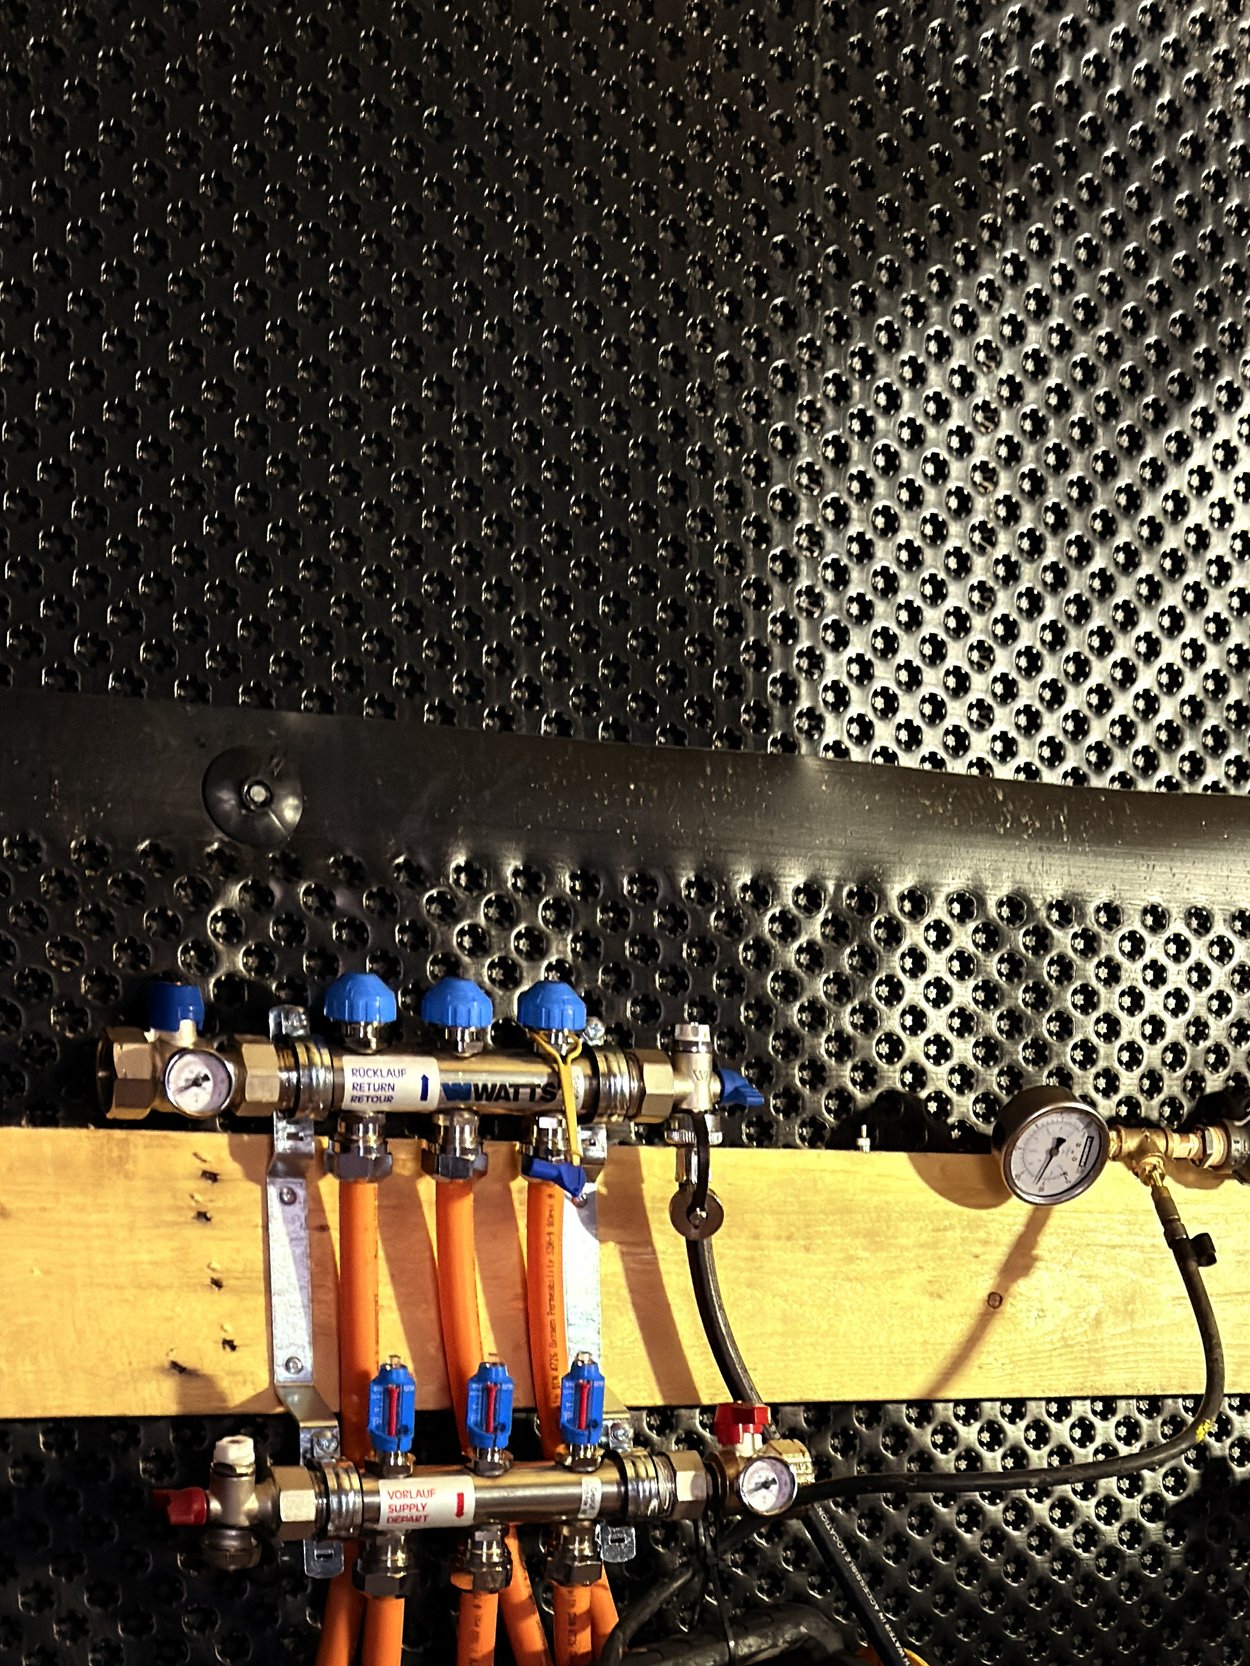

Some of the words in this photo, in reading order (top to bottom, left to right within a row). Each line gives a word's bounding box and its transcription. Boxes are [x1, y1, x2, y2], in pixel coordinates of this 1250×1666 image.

[351, 1082, 395, 1092] RETURN
[473, 1083, 558, 1103] WATTS
[350, 1094, 393, 1104] RETOUR
[387, 1489, 436, 1499] VORLAUF
[388, 1503, 427, 1513] SUPPLY
[846, 1556, 880, 1611] ACCESSIBLE
[877, 1611, 887, 1624] IN
[885, 1623, 905, 1657] WATER
